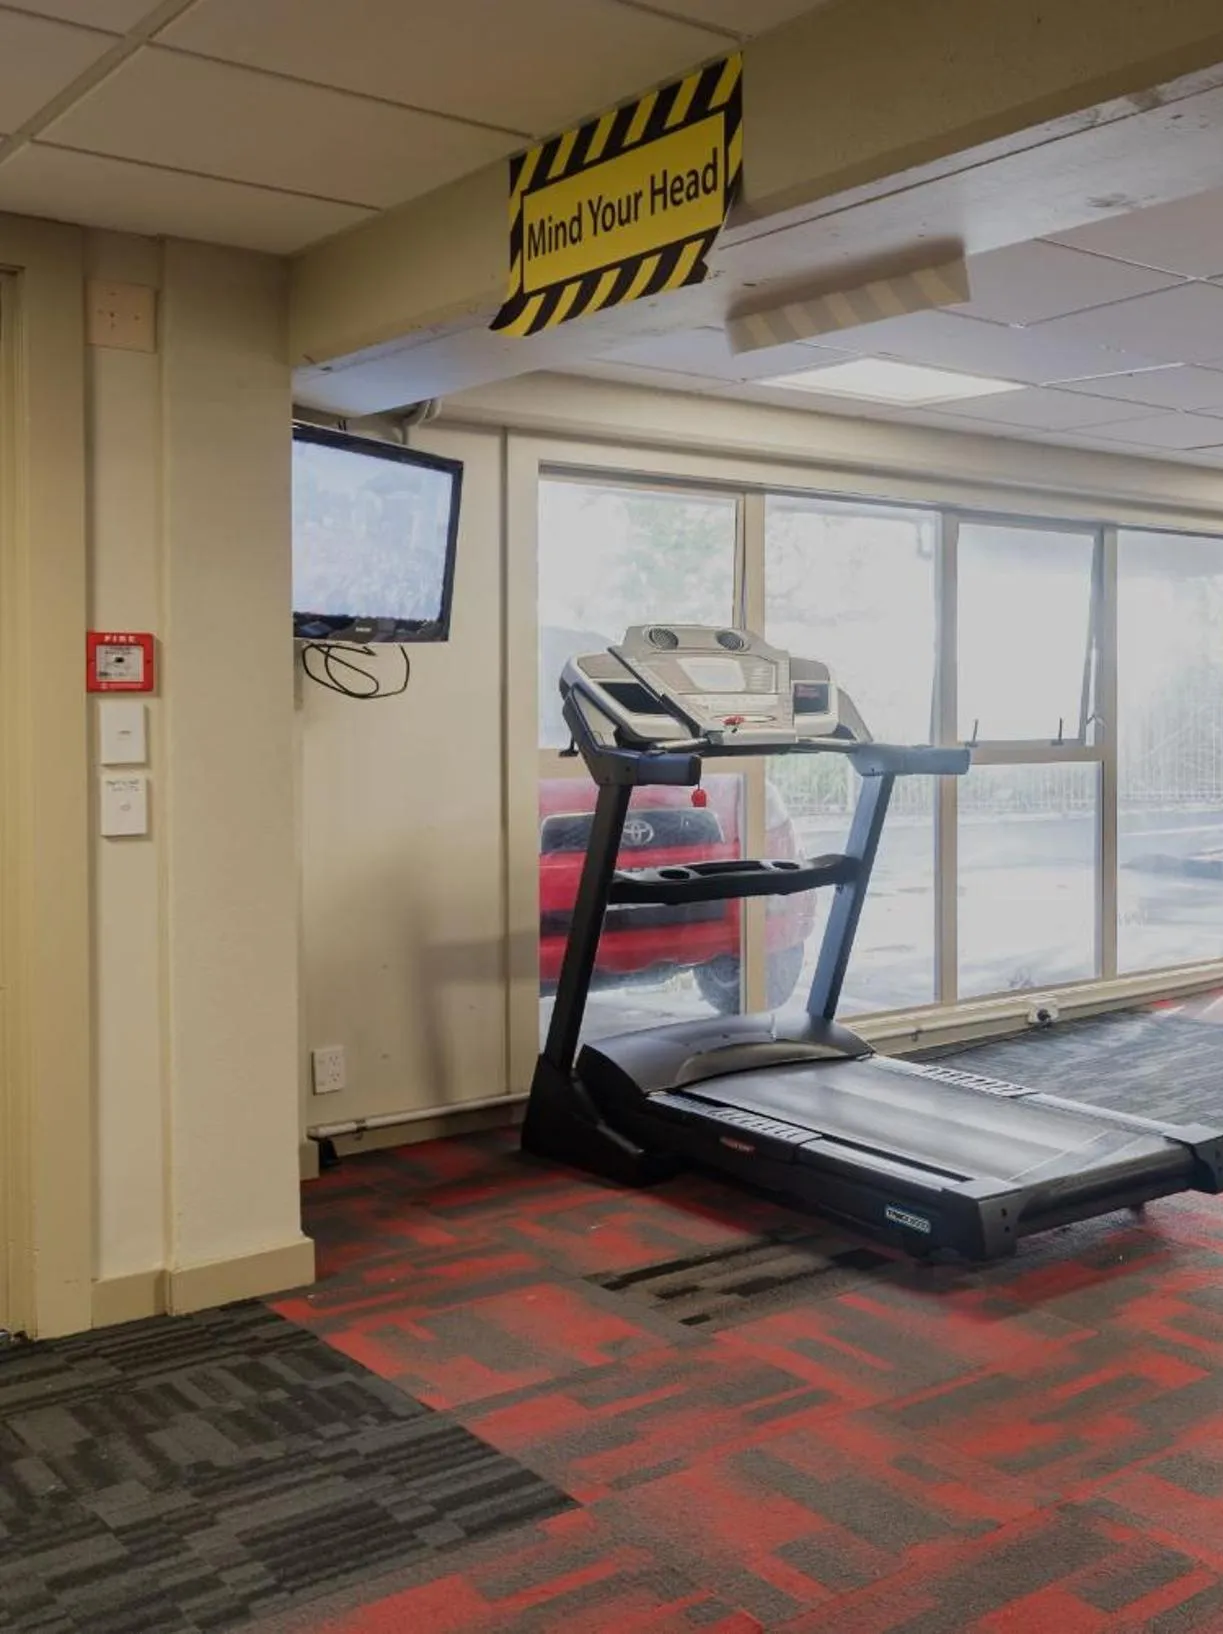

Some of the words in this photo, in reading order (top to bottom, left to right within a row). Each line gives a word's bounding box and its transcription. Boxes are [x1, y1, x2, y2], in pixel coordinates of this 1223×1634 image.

[527, 202, 583, 261] Mind
[588, 189, 643, 237] Your
[650, 147, 718, 217] Head
[104, 635, 136, 643] FIRE
